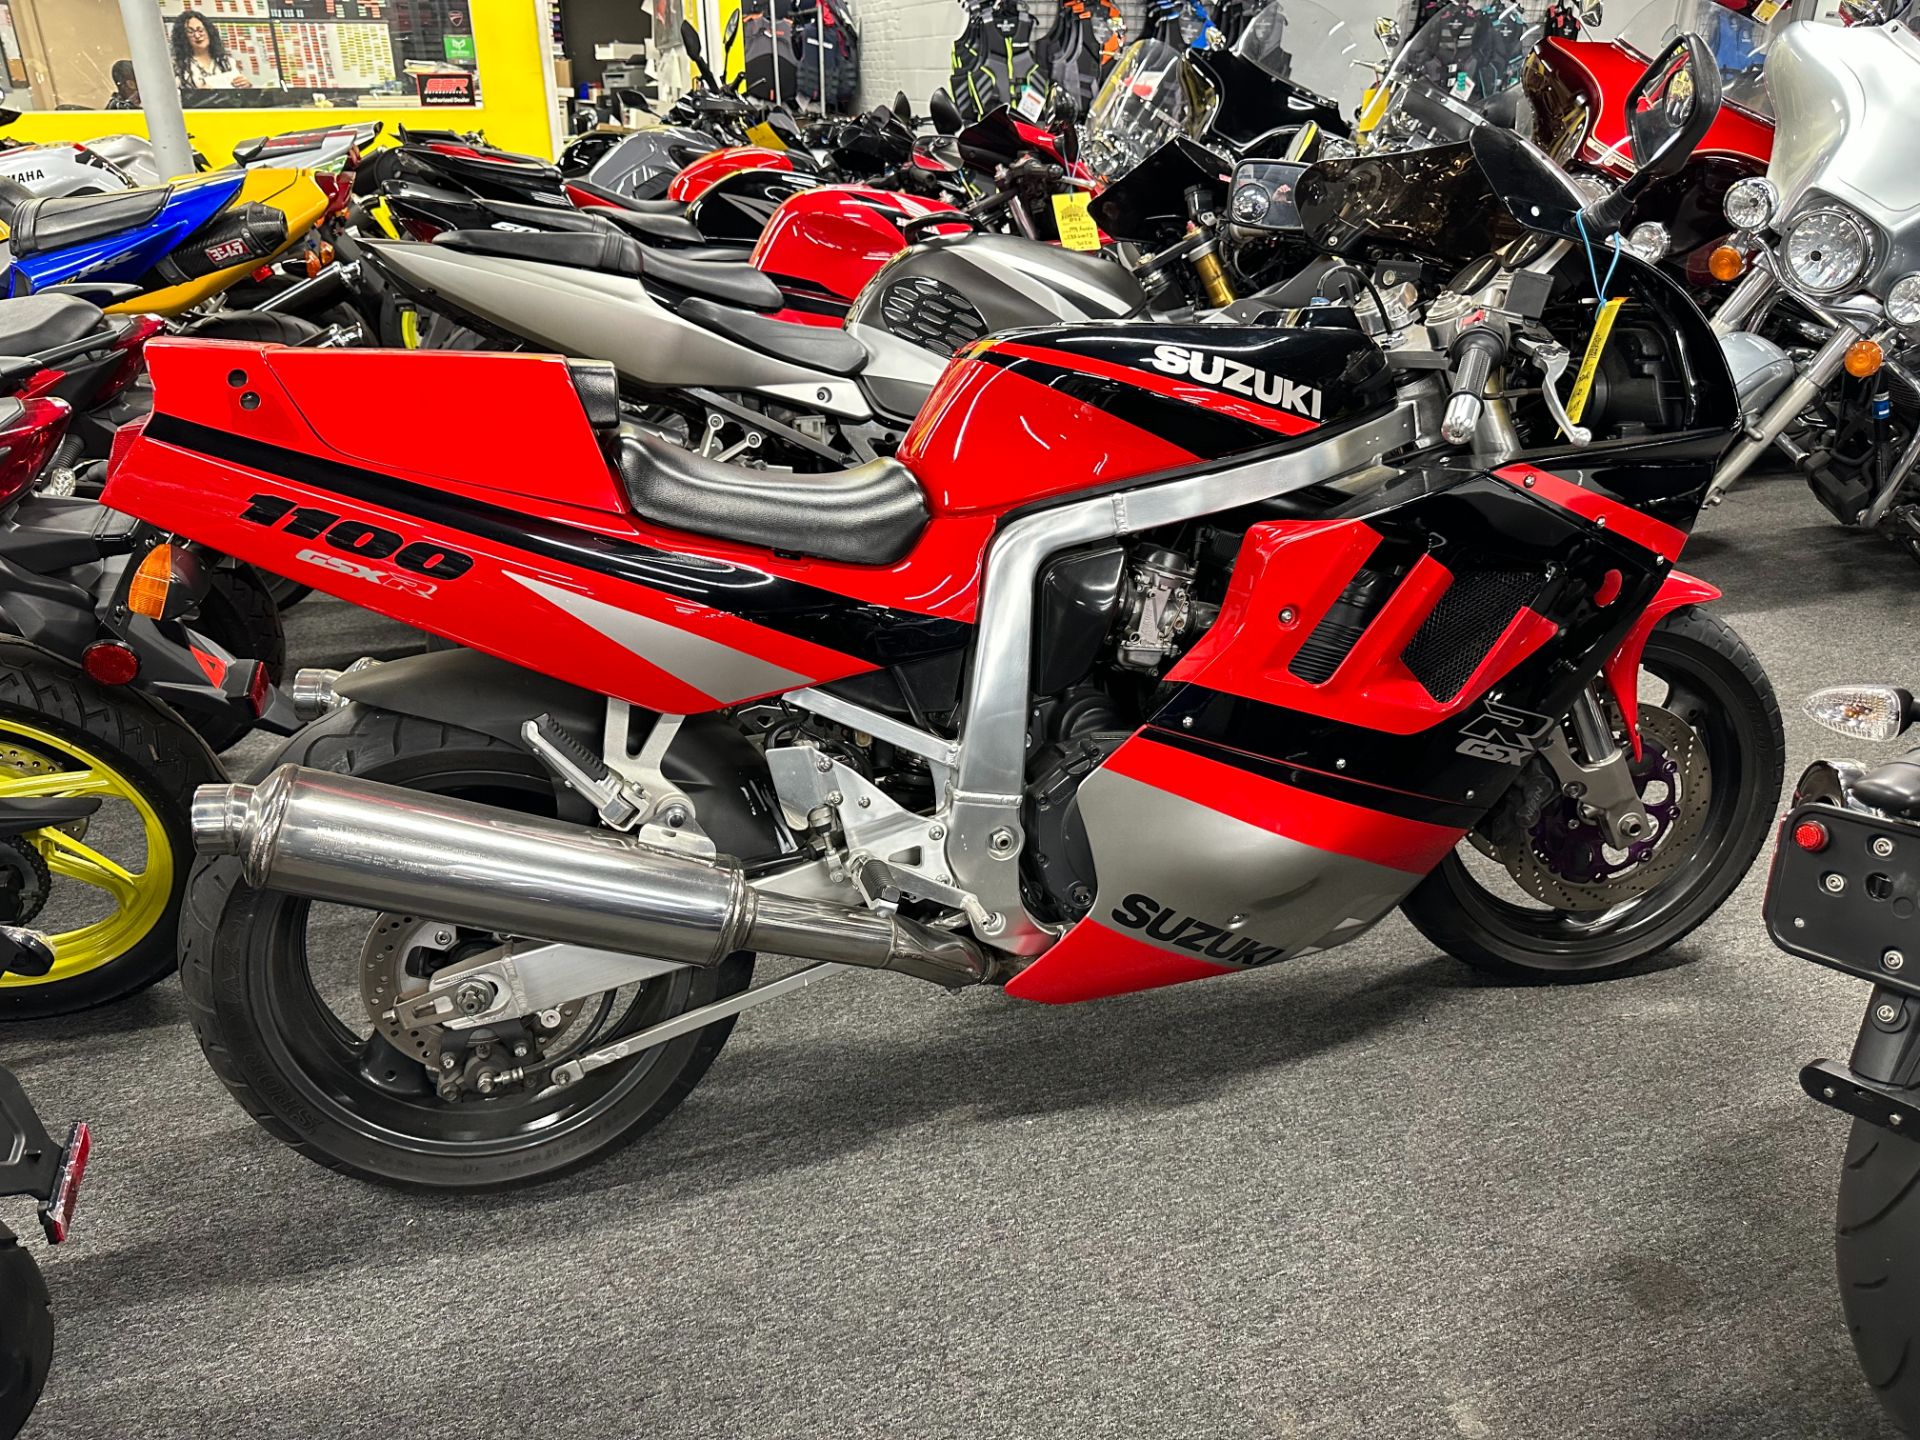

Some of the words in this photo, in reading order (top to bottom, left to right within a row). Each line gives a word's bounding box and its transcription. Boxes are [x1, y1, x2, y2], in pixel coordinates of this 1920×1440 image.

[1152, 345, 1322, 419] SUZUKI
[239, 492, 475, 581] 1100
[1455, 738, 1533, 767] GSX
[1111, 893, 1286, 966] SUZUKI
